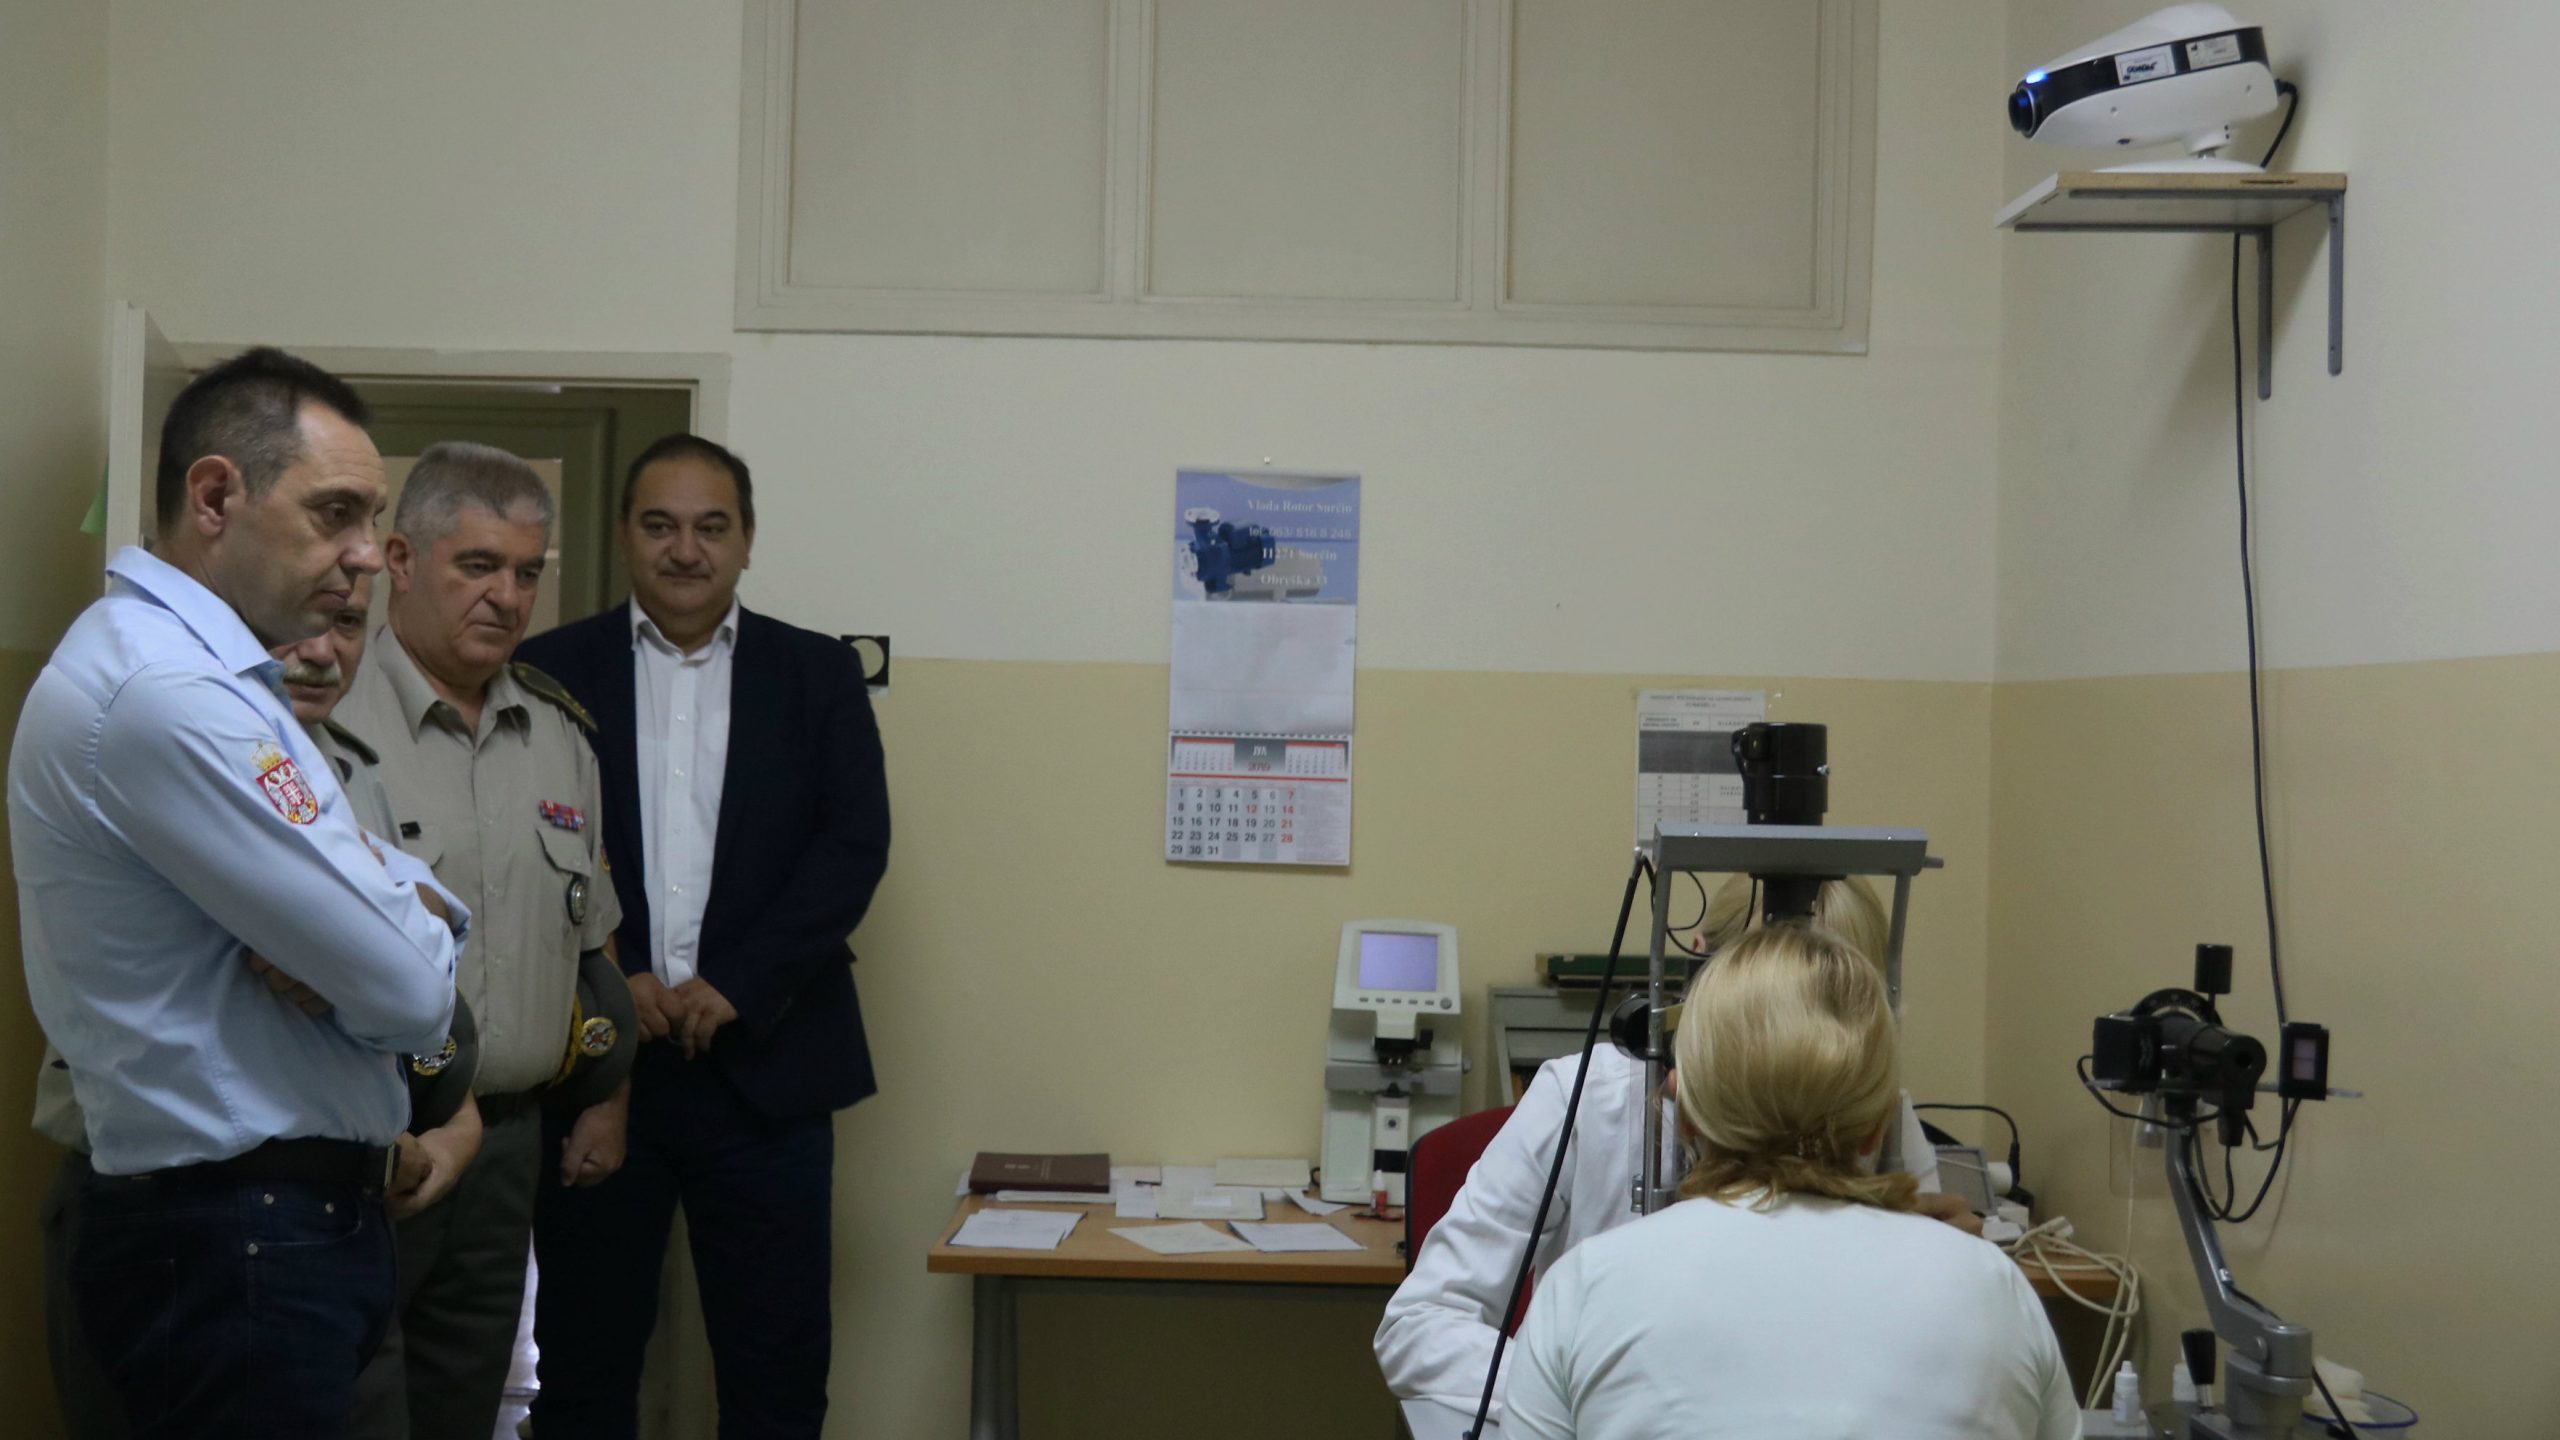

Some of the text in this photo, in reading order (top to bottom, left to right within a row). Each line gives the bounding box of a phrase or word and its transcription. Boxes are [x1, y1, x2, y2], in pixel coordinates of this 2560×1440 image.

[1248, 499, 1279, 512] Vlada
[1282, 500, 1314, 512] Rotor
[1179, 789, 1294, 800] 1 2 3 4 5 6 7
[1178, 803, 1293, 814] 8 9 10 11 12 13 14
[1172, 817, 1292, 828] 15 16 17 18 19 20 21
[1171, 831, 1293, 842] 22 23 24 25 26 27 28
[1170, 845, 1218, 854] 29 30 31
